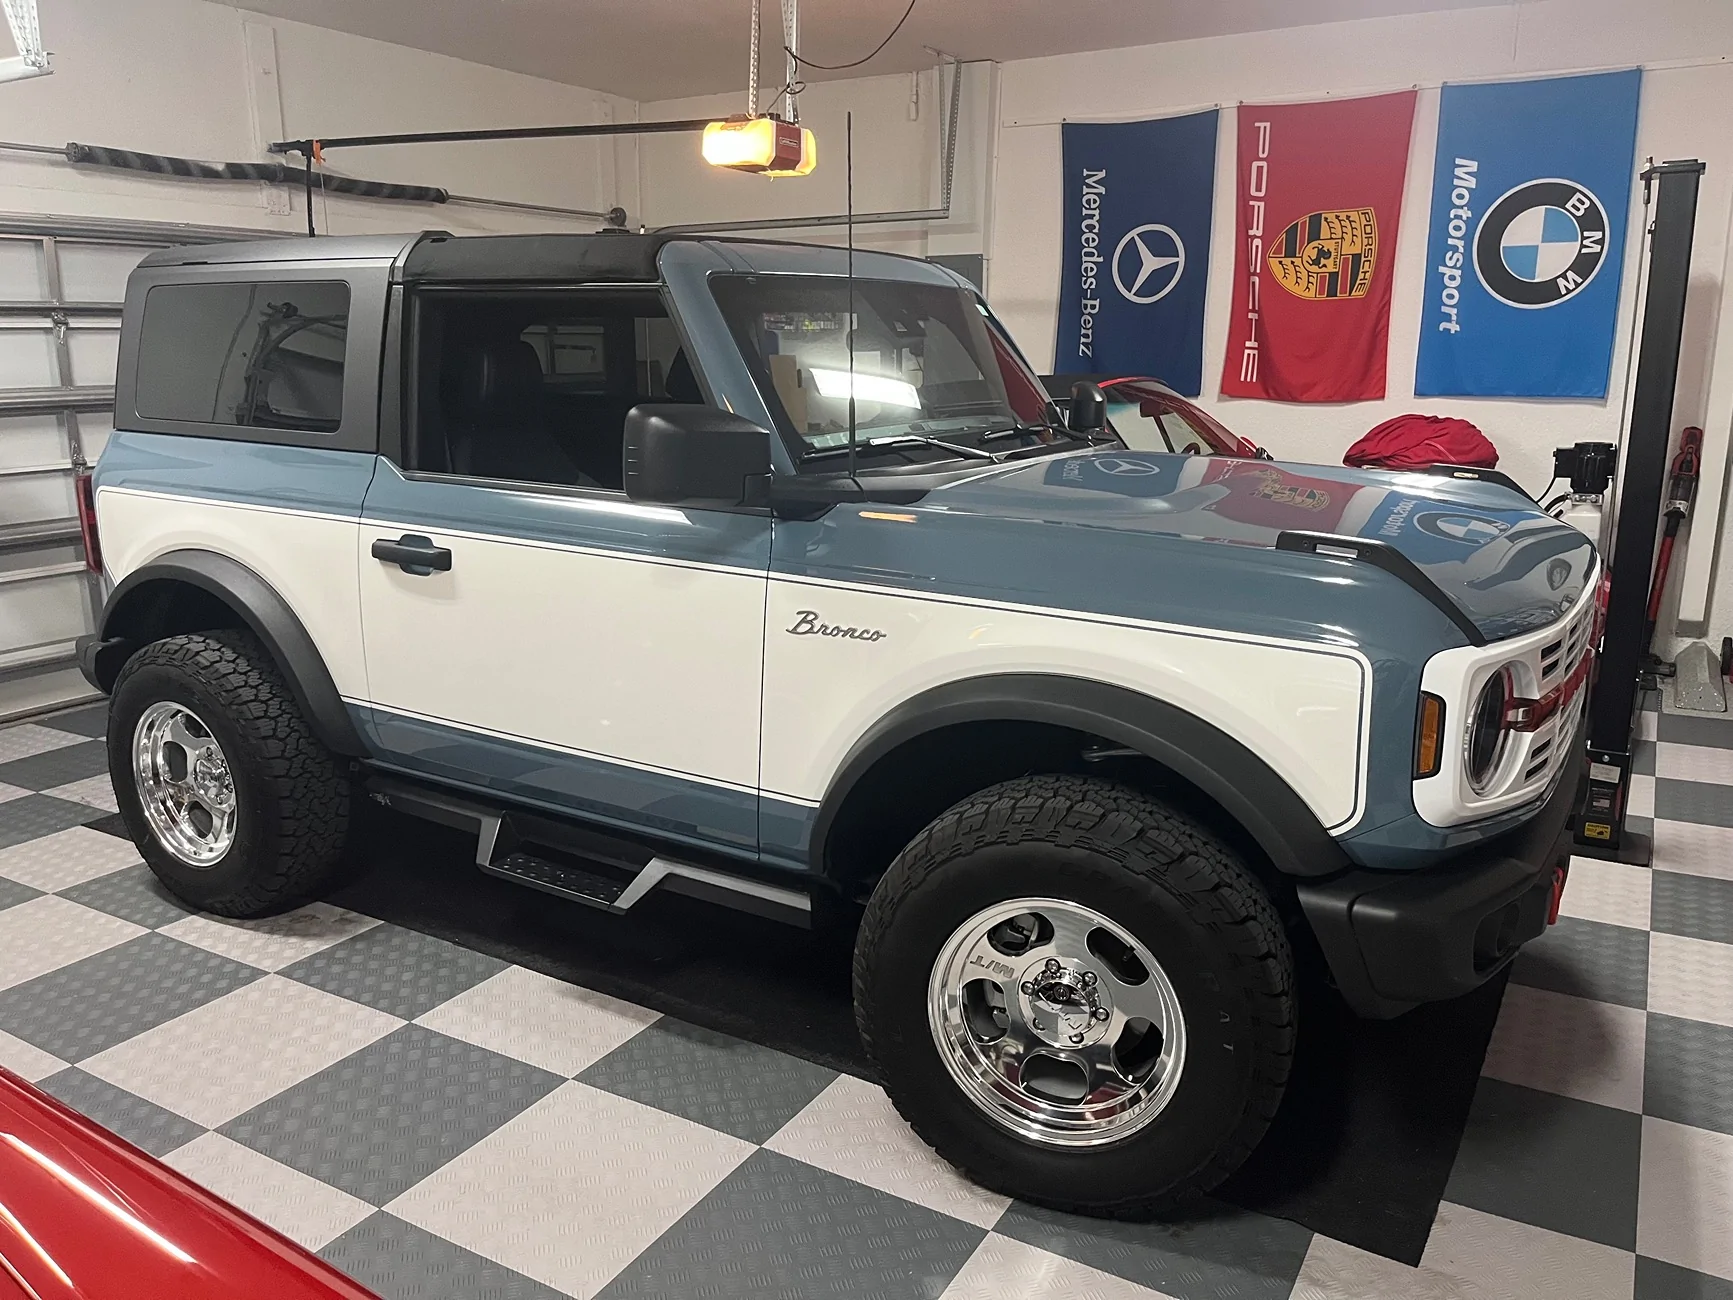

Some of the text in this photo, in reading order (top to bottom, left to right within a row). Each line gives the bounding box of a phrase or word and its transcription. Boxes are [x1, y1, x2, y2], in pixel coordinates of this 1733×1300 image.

[1078, 168, 1106, 358] Mercedes-Benz
[1240, 122, 1271, 383] PORSCHE
[1354, 211, 1373, 294] PORSCHE
[1438, 157, 1479, 334] Motorsport
[1557, 192, 1603, 295] BMW
[785, 610, 887, 642] Bronco
[969, 955, 1016, 979] M/T
